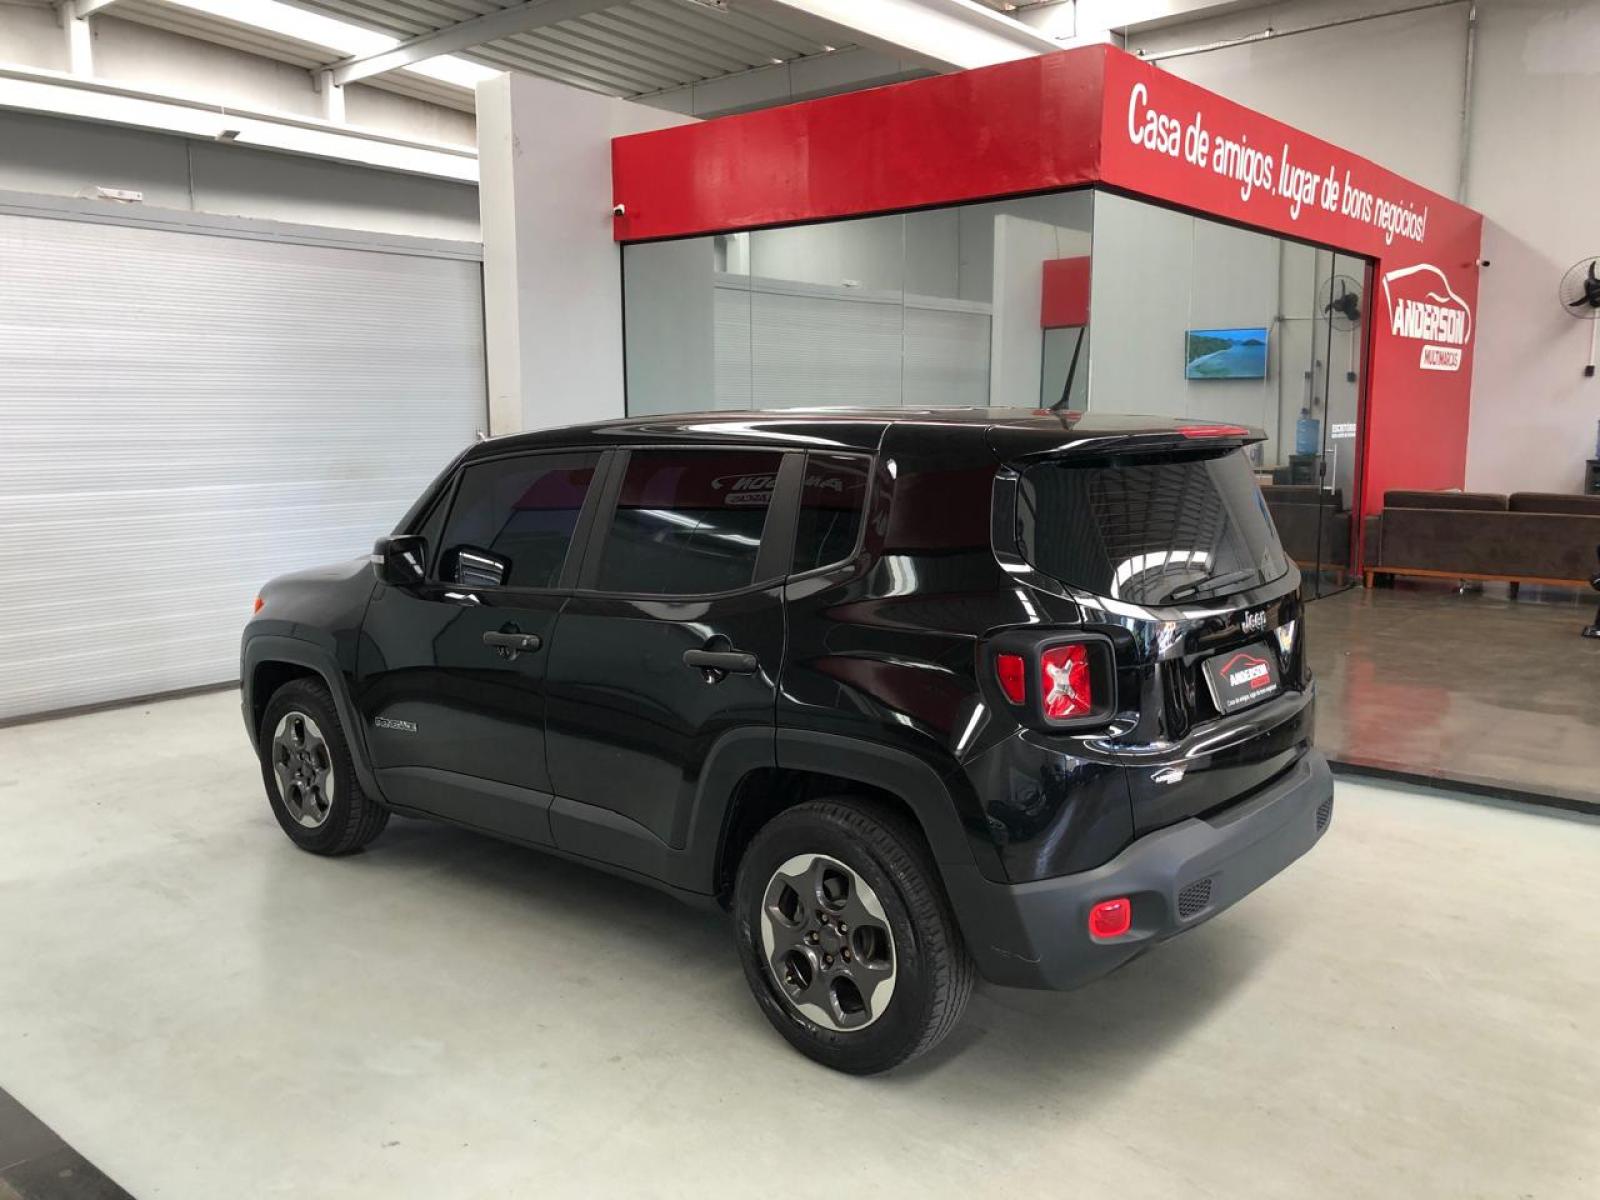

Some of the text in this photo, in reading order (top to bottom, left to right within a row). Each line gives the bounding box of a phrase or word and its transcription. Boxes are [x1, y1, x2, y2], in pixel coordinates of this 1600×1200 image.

[1128, 82, 1428, 245] Casa de amigos, lugar de bons negócios!
[1392, 298, 1465, 344] ANDERSON
[1424, 349, 1459, 368] MULTIMARCAS
